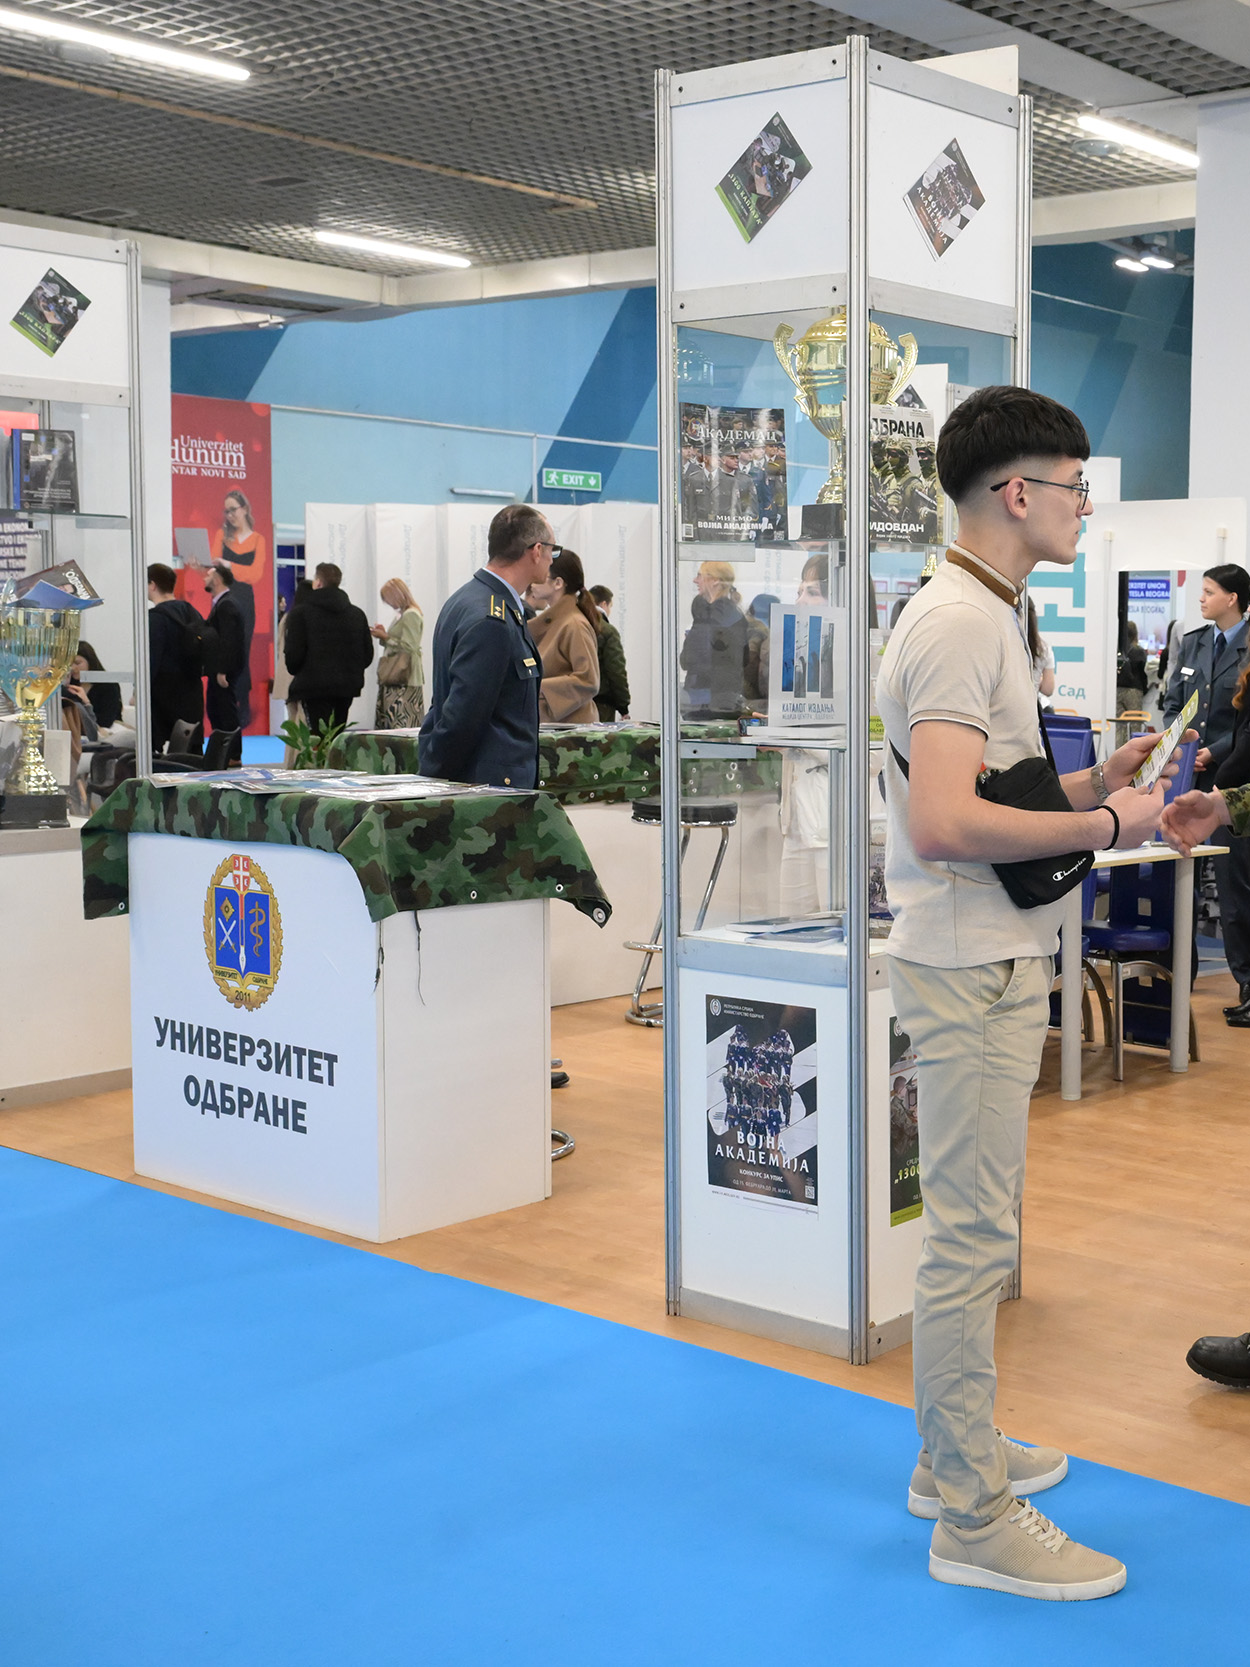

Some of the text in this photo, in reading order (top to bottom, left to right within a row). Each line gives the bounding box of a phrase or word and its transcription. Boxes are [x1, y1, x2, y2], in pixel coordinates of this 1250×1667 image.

[697, 427, 777, 442] АКАДЕМАЦ
[870, 418, 924, 438] ДБРАНА
[180, 434, 244, 452] Univerzitet
[171, 438, 246, 468] dunum
[172, 466, 246, 480] NTAR NOVI SAD
[562, 474, 584, 486] EXIT
[698, 521, 773, 530] ВОЈНА АКАДЕМИА
[870, 521, 924, 534] ИДОВДАН
[1058, 684, 1086, 700] Сад
[782, 703, 835, 713] КАТАЛОГ ИЗДАЊА
[1052, 857, 1087, 881] Champion
[235, 989, 251, 1003] 2011
[153, 1016, 338, 1087] УНИВЕРЗИТЕТ
[183, 1074, 308, 1135] ОДБРАНЕ
[737, 1131, 786, 1151] ВОЈНА
[715, 1144, 809, 1173] АКАДЕМИЈА
[739, 1168, 762, 1178] КОНКУРС
[770, 1174, 784, 1182] УПИС
